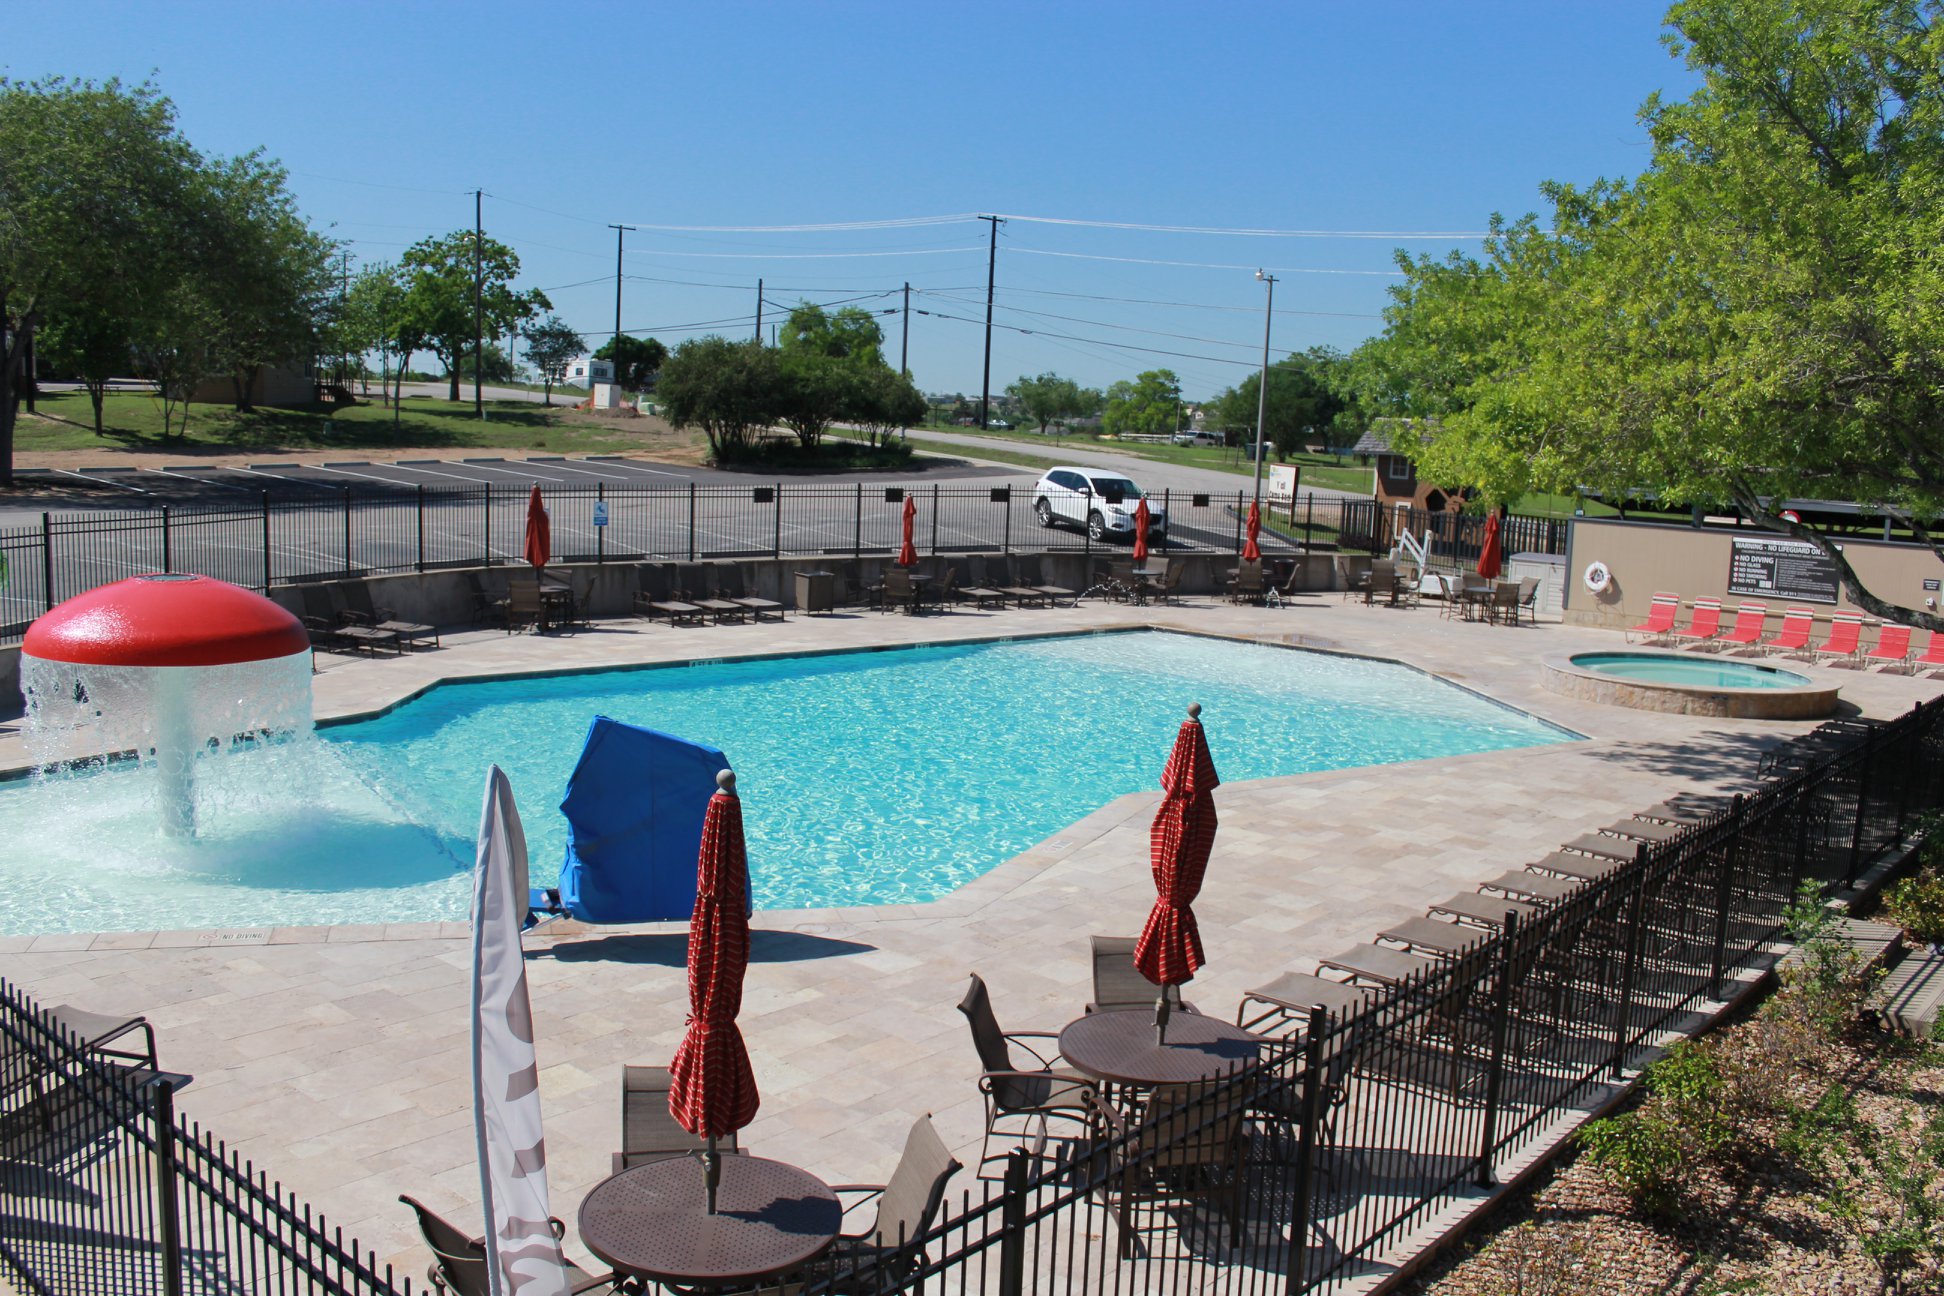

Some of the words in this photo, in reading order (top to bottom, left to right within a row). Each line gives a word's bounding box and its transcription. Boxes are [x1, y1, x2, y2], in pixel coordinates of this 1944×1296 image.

[1735, 542, 1764, 550] WARNING
[1778, 546, 1810, 555] LIFEGUARD
[1751, 555, 1774, 564] DIVING
[236, 932, 264, 940] DIVING
